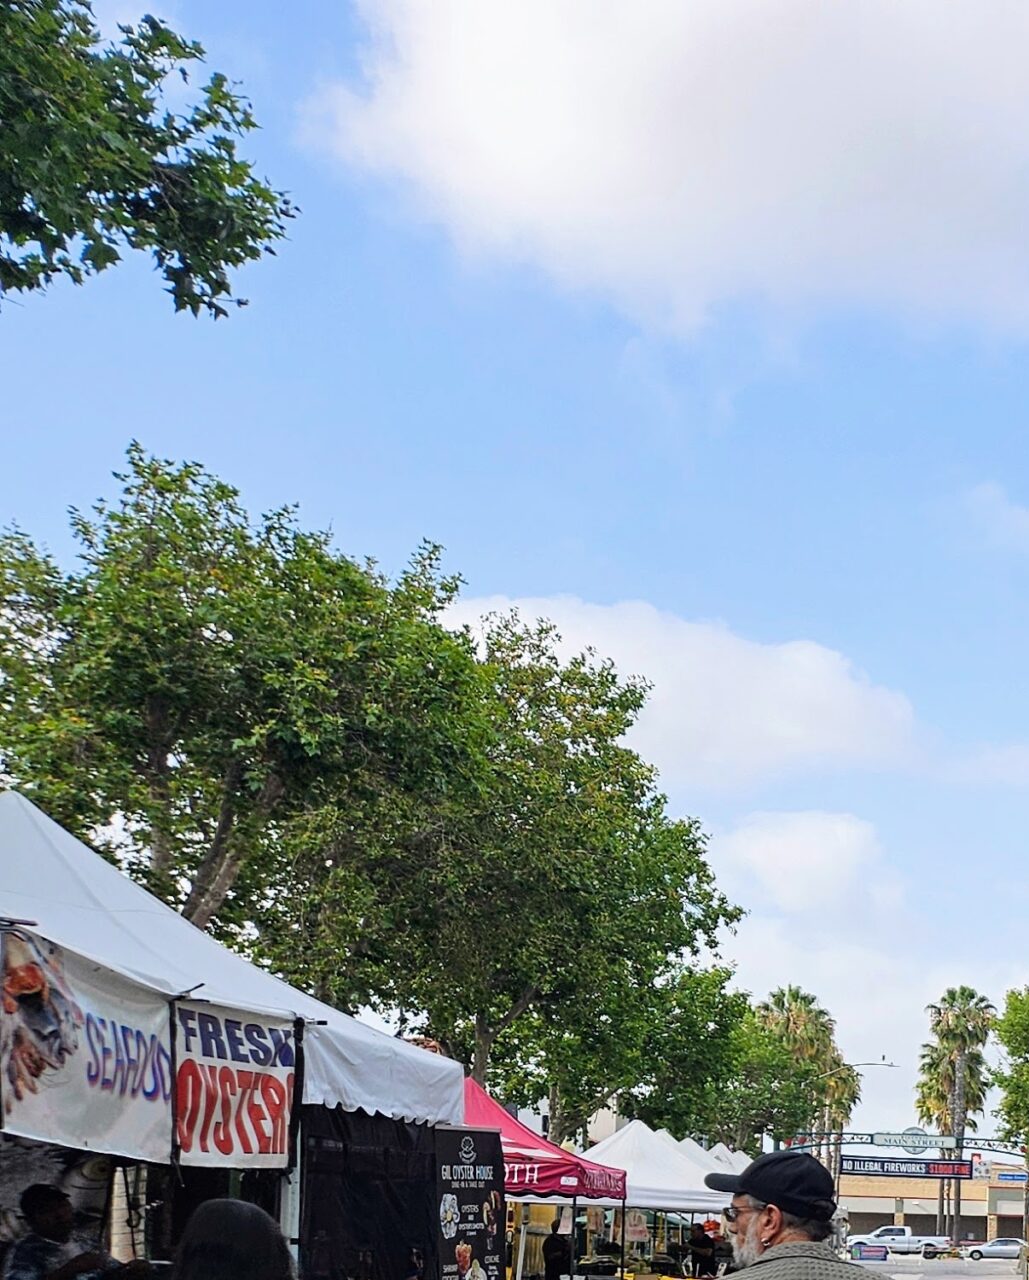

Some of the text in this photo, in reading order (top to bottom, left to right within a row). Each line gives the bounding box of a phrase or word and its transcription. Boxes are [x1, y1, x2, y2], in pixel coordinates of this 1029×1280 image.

[884, 1137, 908, 1145] MAIN
[911, 1138, 945, 1147] STREET
[441, 1165, 494, 1180] GIL OYSTER HOUSE
[842, 1160, 970, 1175] NO ILLEGAL FIREWORKS $1000 FINE
[461, 1205, 480, 1213] OYSTERS
